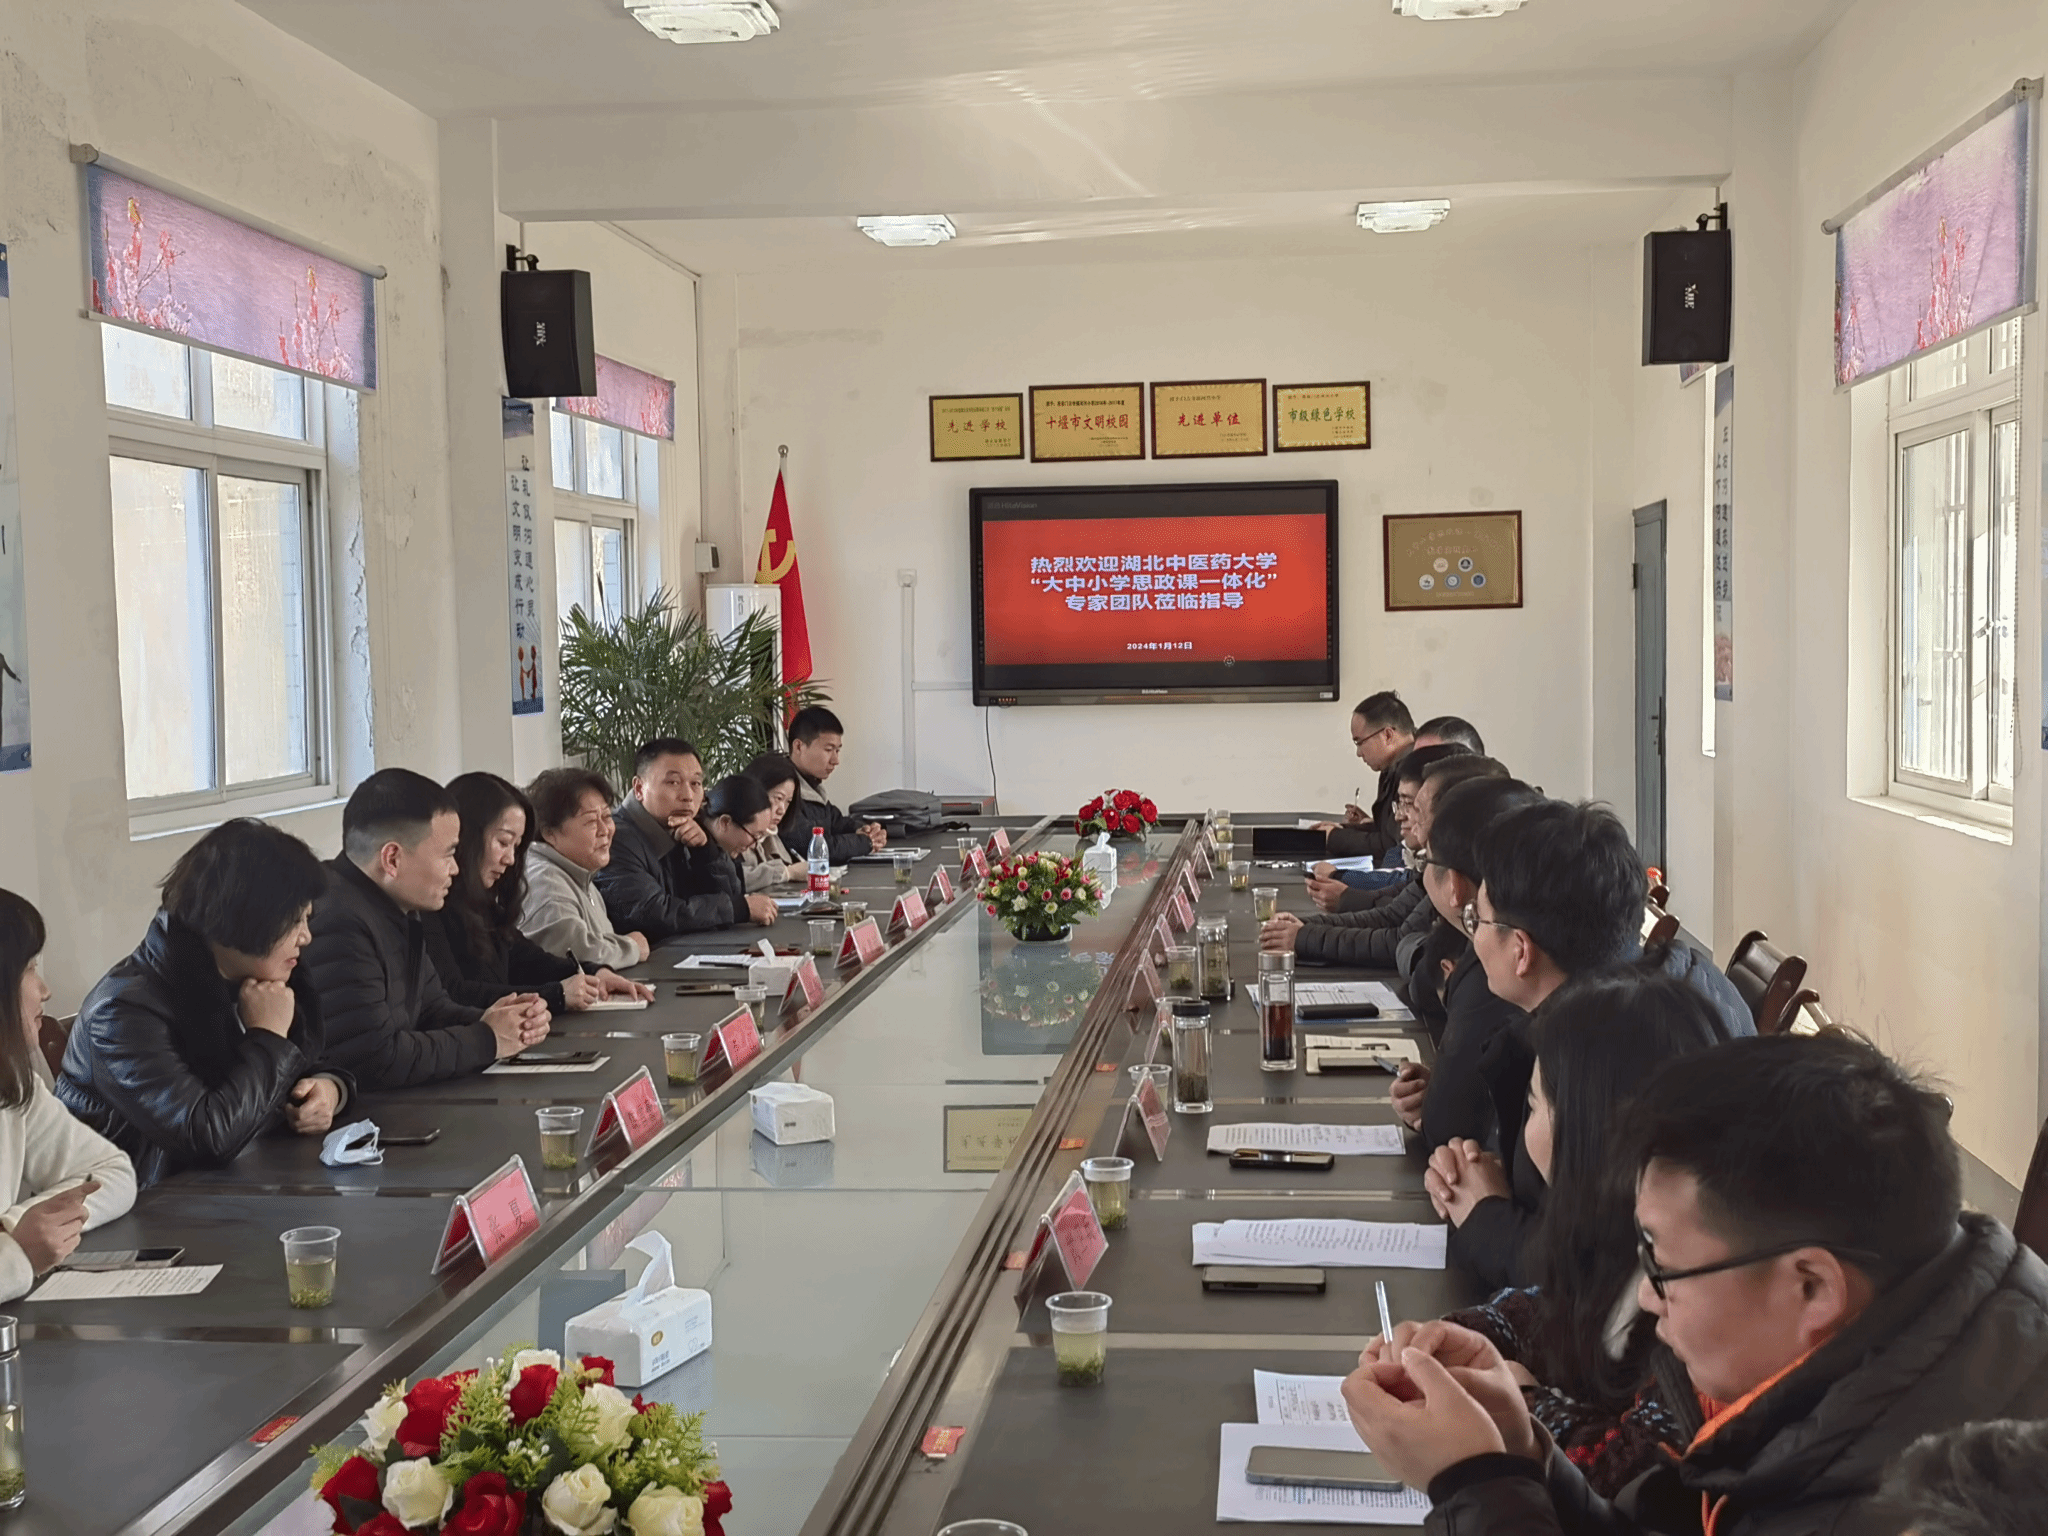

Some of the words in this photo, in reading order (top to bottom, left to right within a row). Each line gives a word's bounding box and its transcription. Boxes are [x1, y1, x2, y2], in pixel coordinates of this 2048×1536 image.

[947, 418, 1008, 433] 先进学校
[1045, 413, 1129, 431] 十堰市文明校园
[1177, 411, 1241, 427] 先进单位
[1030, 552, 1278, 574] 热烈欢迎湖北中医药大学
[1030, 572, 1277, 593] “大中小学思政课一体化”
[1065, 592, 1244, 611] 专家团队莅临指导
[1126, 641, 1193, 651] 2024年1月12日
